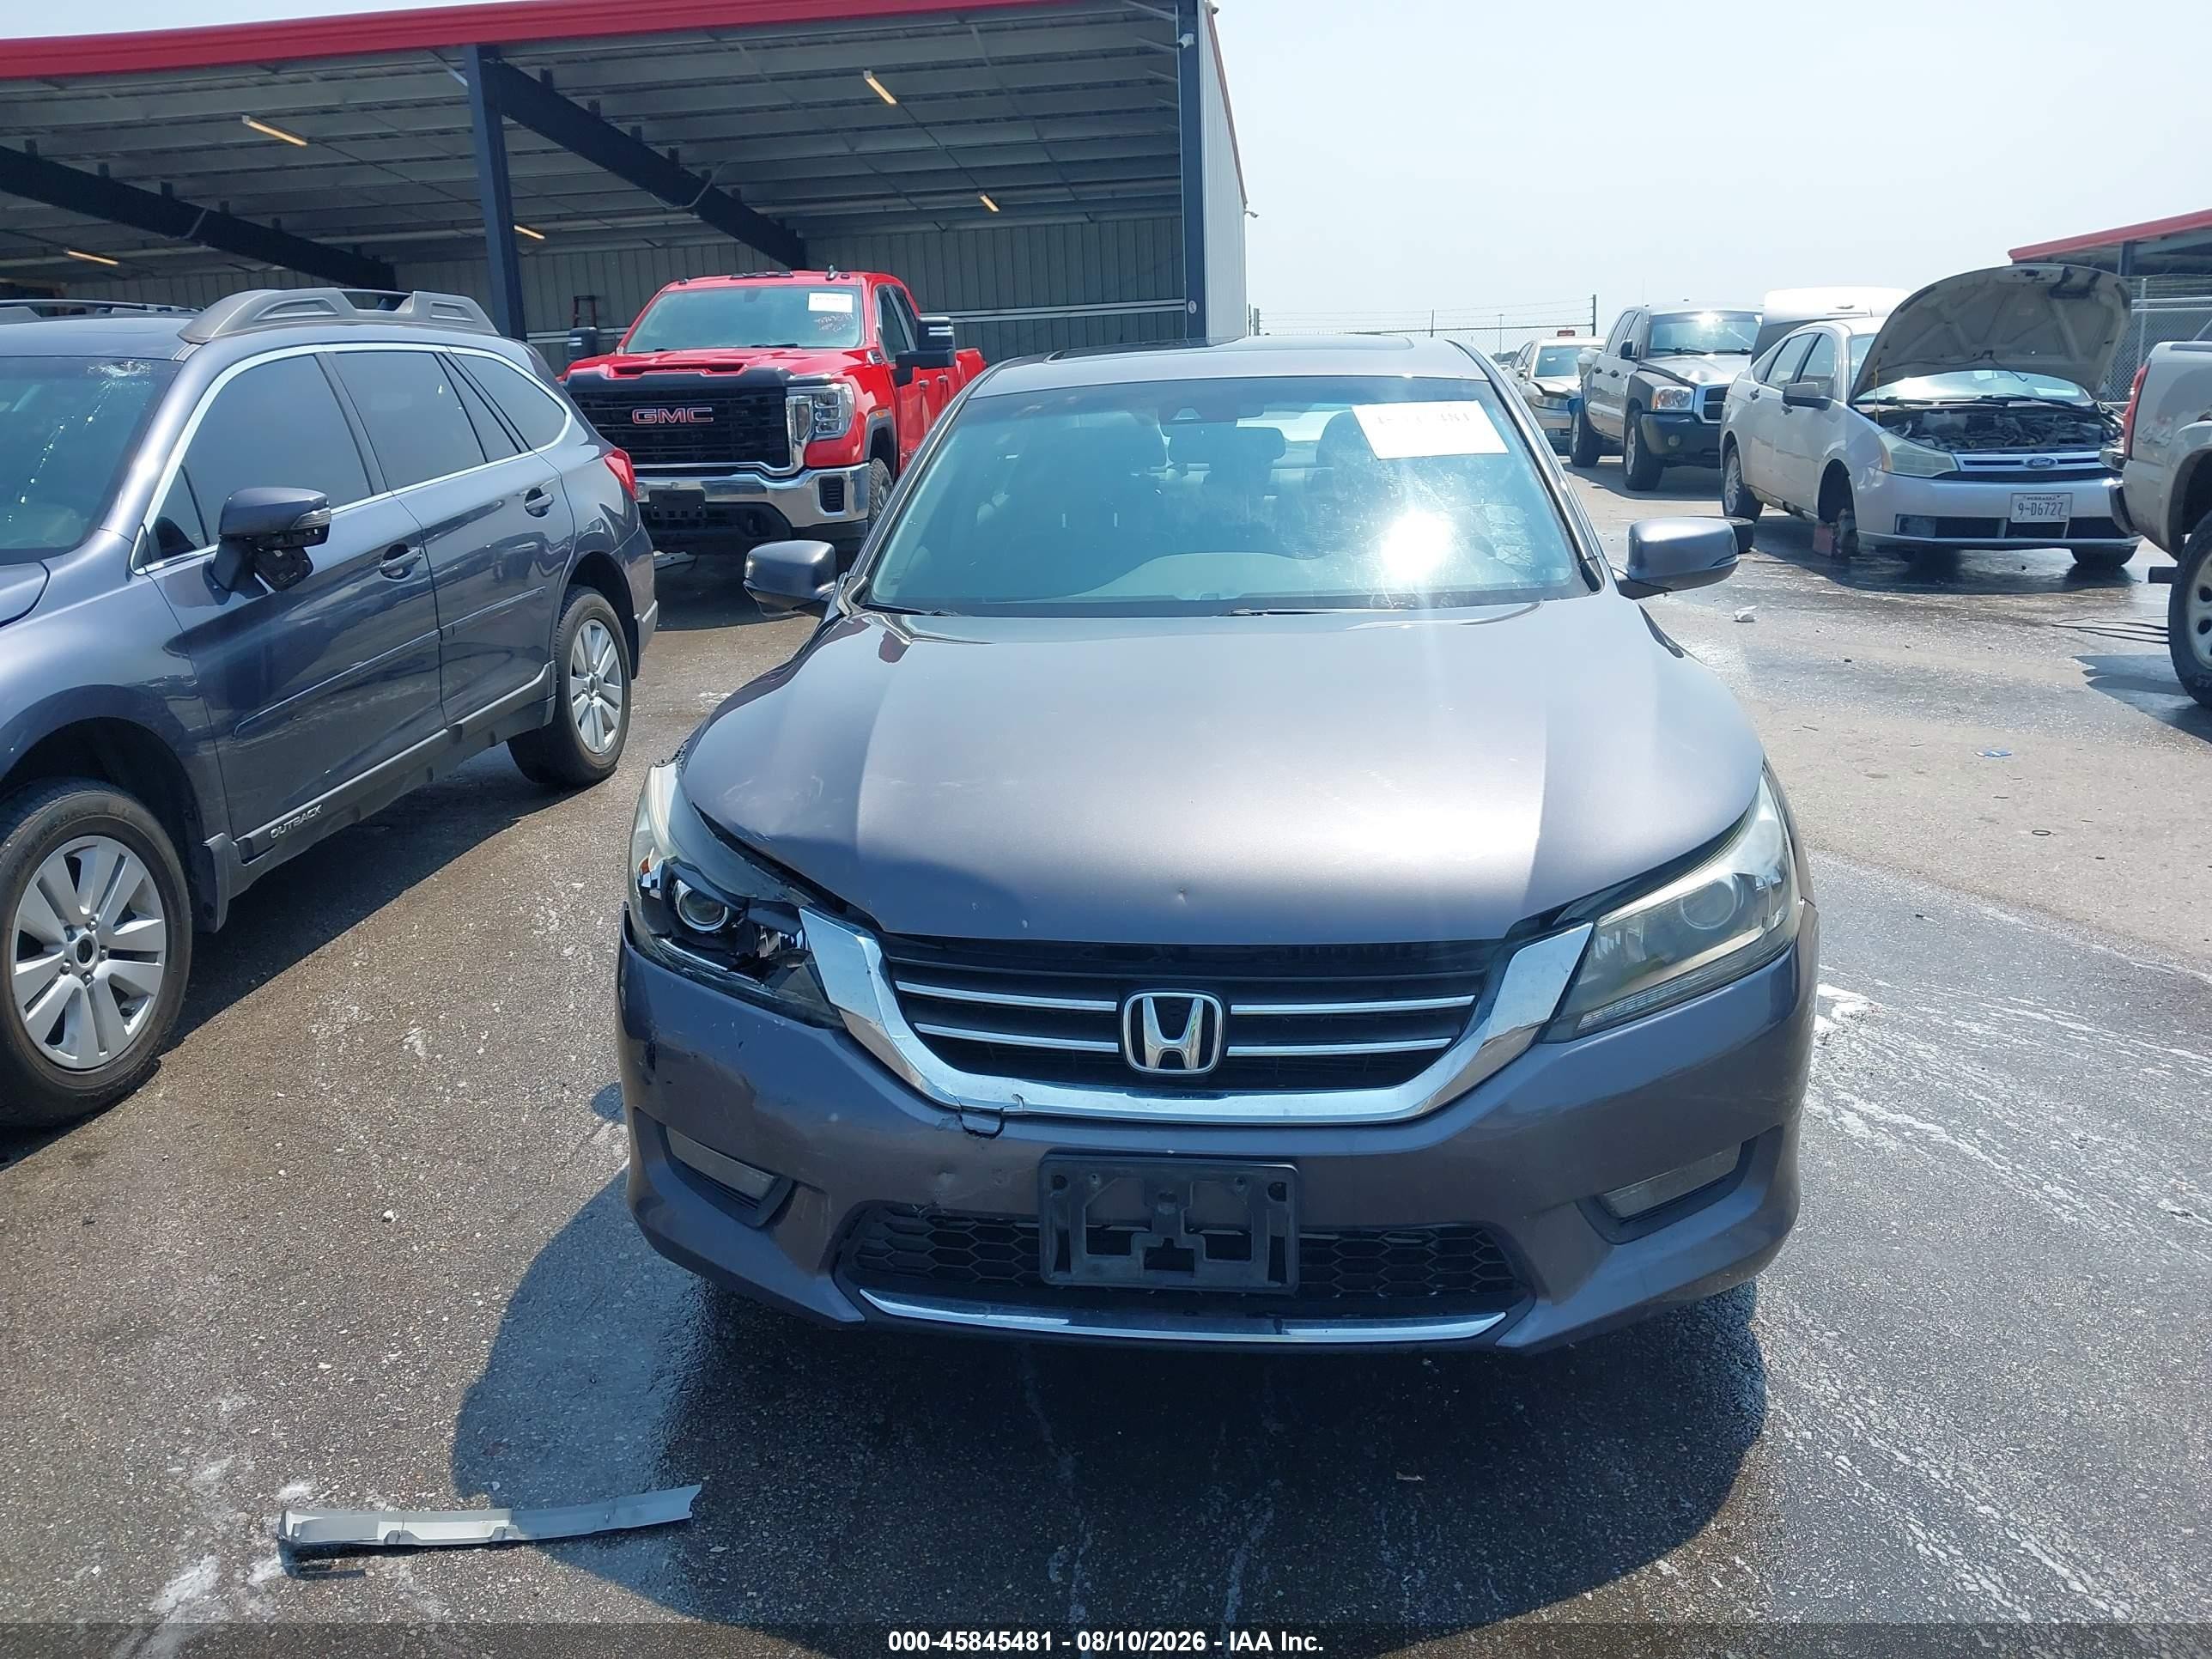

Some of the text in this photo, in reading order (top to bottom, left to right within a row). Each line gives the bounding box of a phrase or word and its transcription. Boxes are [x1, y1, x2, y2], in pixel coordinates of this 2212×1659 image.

[632, 407, 714, 424] GMC
[2018, 502, 2064, 516] 9-D6727
[270, 804, 323, 839] OUTBACK
